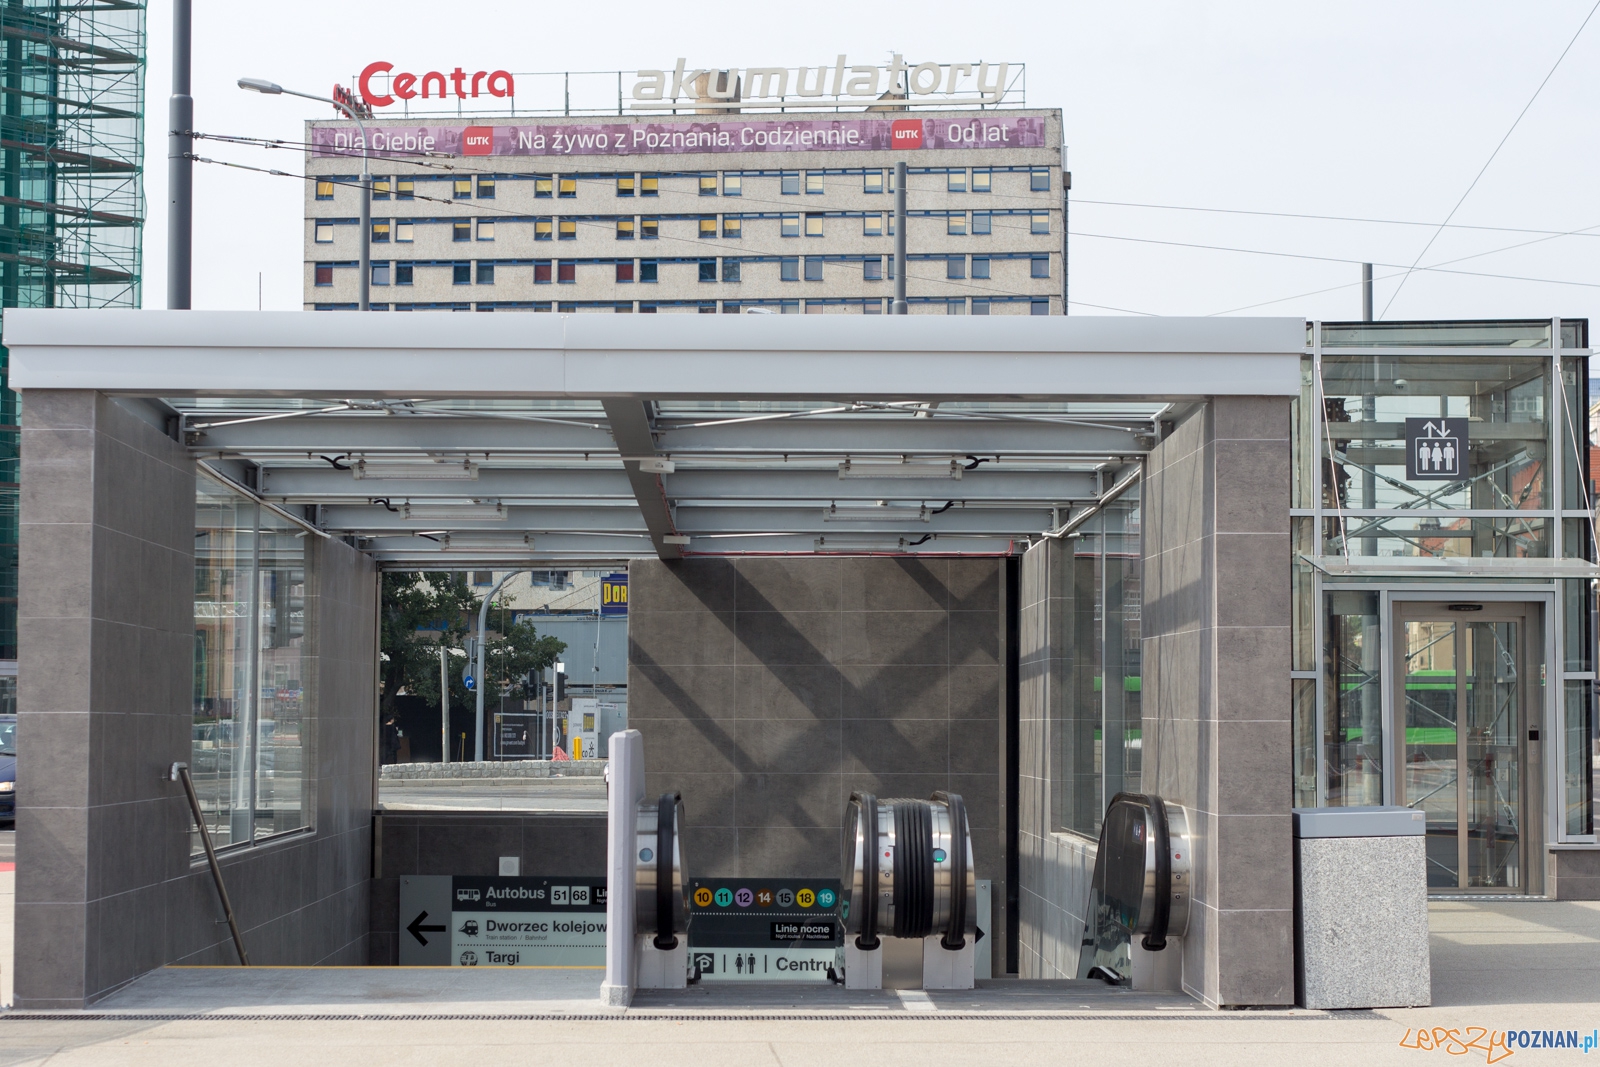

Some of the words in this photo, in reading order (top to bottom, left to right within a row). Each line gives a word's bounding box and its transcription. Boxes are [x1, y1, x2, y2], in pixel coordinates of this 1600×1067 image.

[358, 61, 514, 108] Centra
[631, 54, 1009, 106] akumulatory
[334, 132, 366, 151] Dla
[372, 132, 436, 152] Ciebie
[518, 131, 546, 149] Na
[552, 129, 608, 153] żywo
[614, 134, 626, 148] z
[633, 128, 736, 149] Poznania.
[742, 127, 865, 147] Codziennie.
[947, 124, 976, 144] Od
[982, 122, 1010, 144] lat
[485, 886, 546, 899] Autobus
[553, 890, 567, 901] 51
[573, 890, 587, 901] 68
[596, 889, 607, 898] Li
[697, 892, 709, 904] 10
[718, 892, 728, 904] 11
[738, 892, 750, 904] 12
[758, 892, 771, 904] 14
[779, 892, 791, 904] 15
[800, 892, 812, 904] 18
[820, 892, 833, 904] 19
[486, 920, 548, 932] Dworzec
[553, 921, 607, 935] kolejow
[775, 924, 798, 933] Linie
[485, 951, 520, 966] Targi
